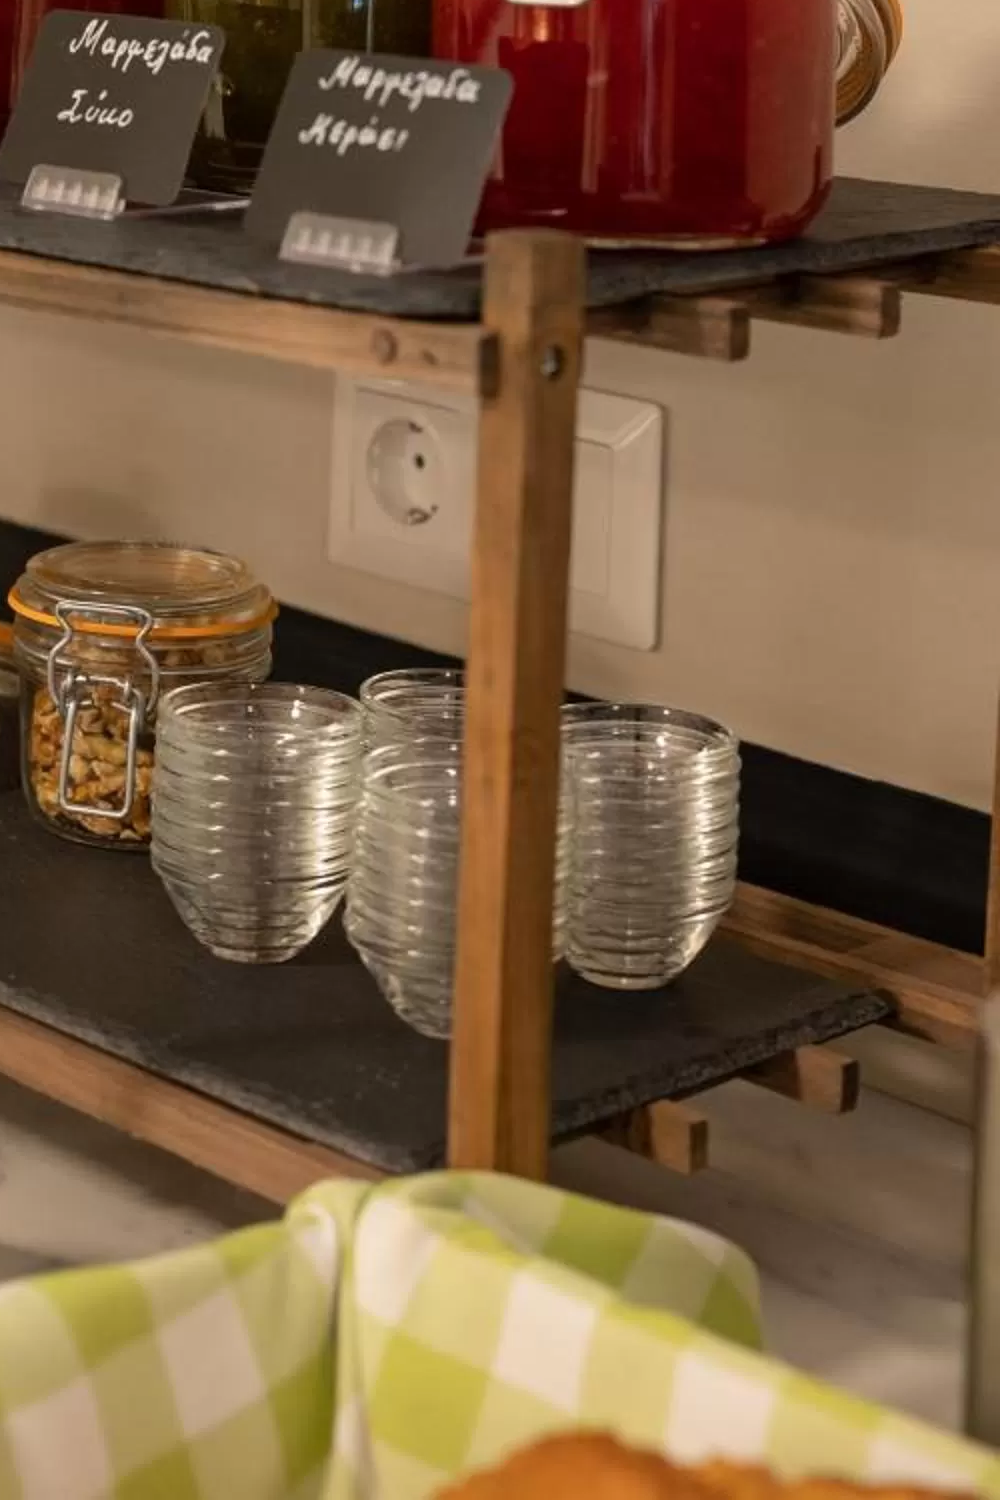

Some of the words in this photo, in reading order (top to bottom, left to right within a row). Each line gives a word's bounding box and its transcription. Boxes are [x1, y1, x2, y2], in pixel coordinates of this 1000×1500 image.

[69, 18, 215, 75] Μαρμελάδα
[57, 89, 134, 128] Σύκο
[297, 112, 409, 156] Κεράσι
